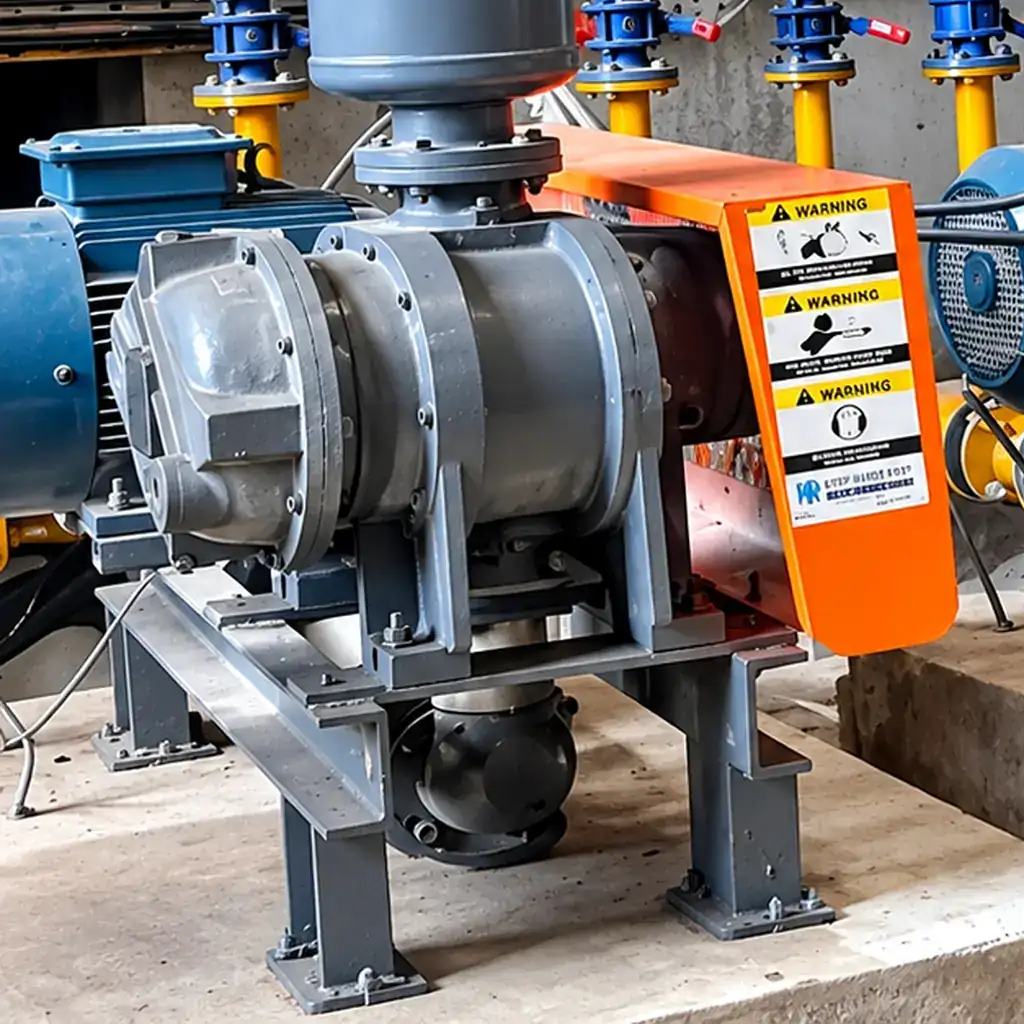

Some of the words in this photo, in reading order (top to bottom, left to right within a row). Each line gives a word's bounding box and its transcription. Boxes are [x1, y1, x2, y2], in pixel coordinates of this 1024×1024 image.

[795, 197, 868, 219] WARNING
[806, 288, 880, 311] WARNING
[820, 378, 892, 403] WARNING
